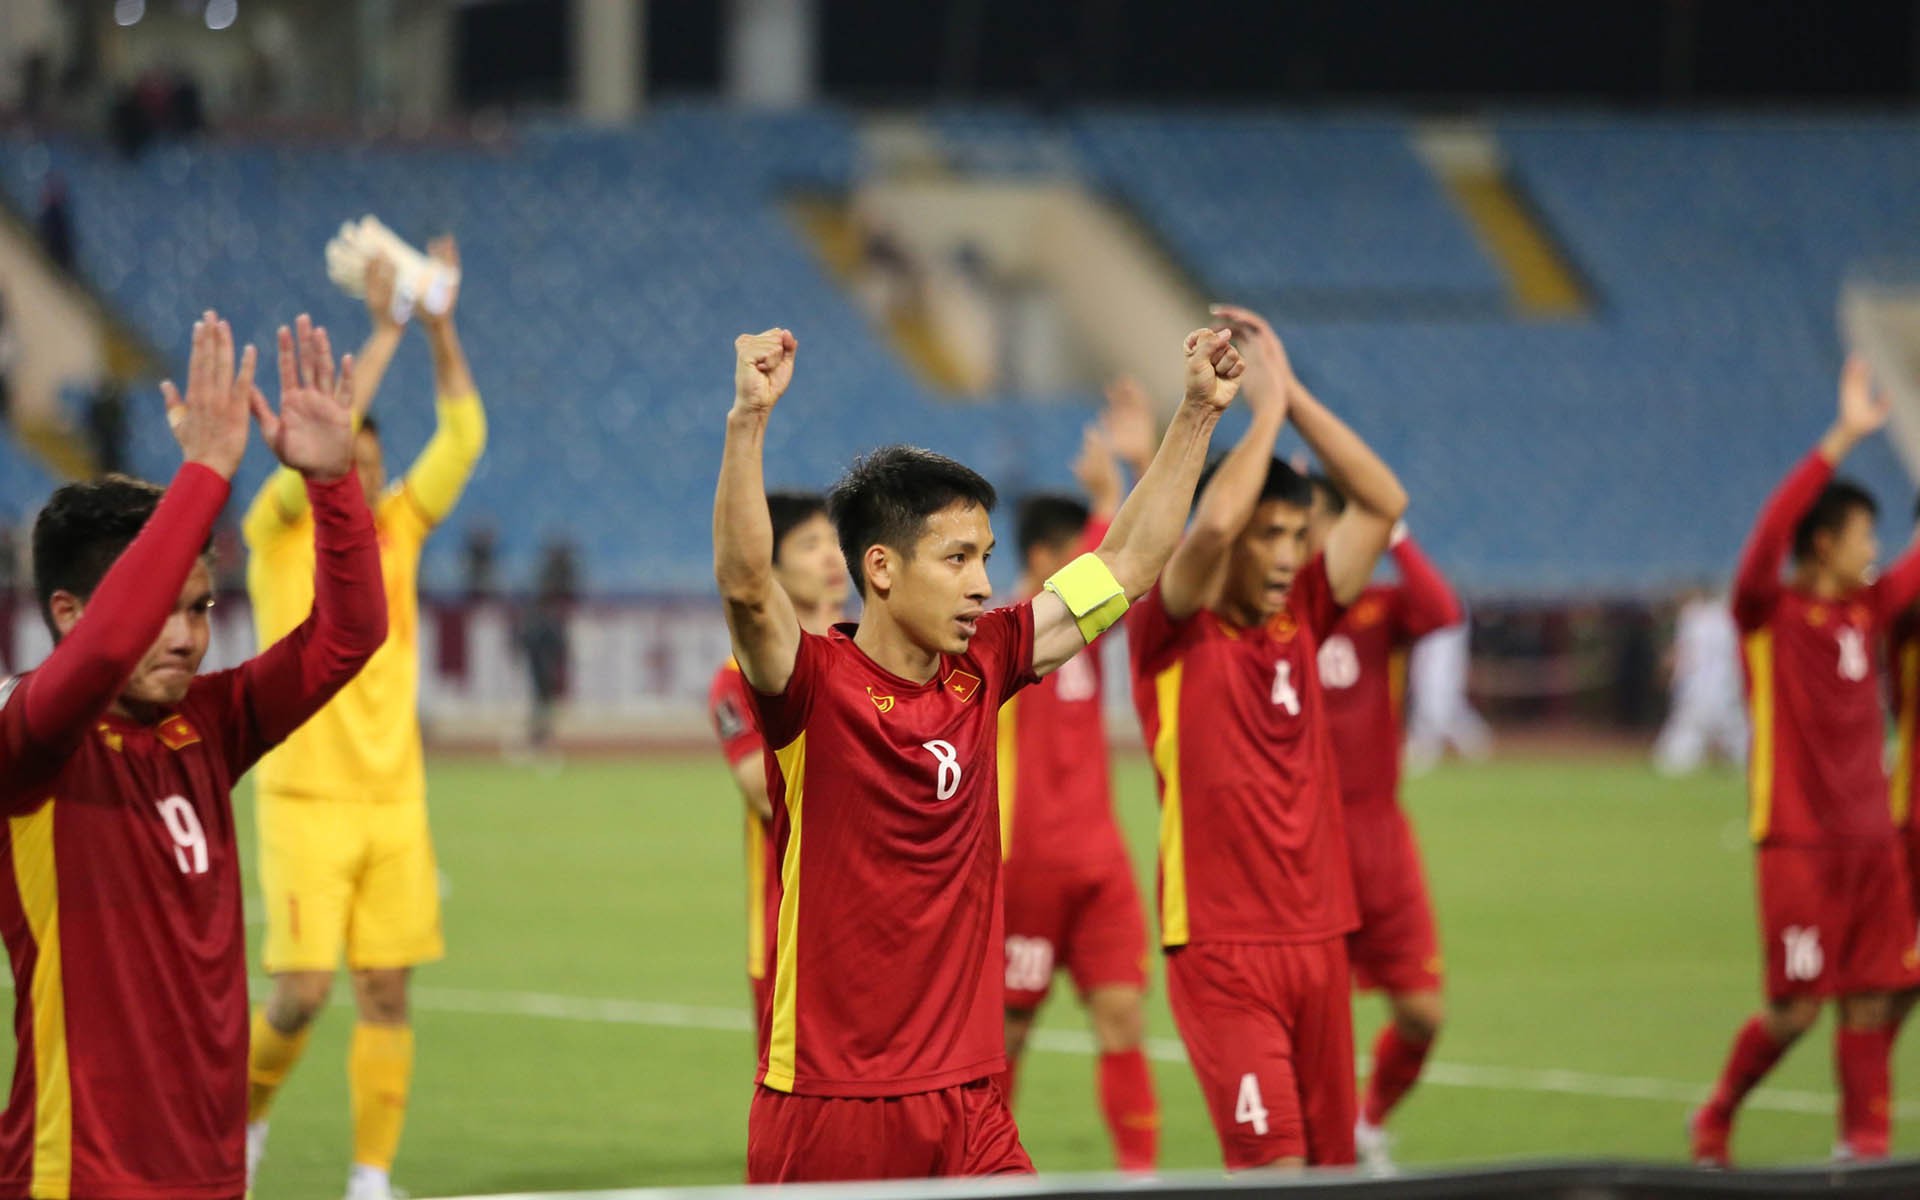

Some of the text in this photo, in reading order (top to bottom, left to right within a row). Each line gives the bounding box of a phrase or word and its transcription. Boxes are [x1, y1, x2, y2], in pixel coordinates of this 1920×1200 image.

[1272, 659, 1301, 716] 4
[922, 739, 962, 801] 8
[155, 794, 209, 875] 19
[1781, 925, 1824, 981] 16
[1235, 1072, 1269, 1135] 4
